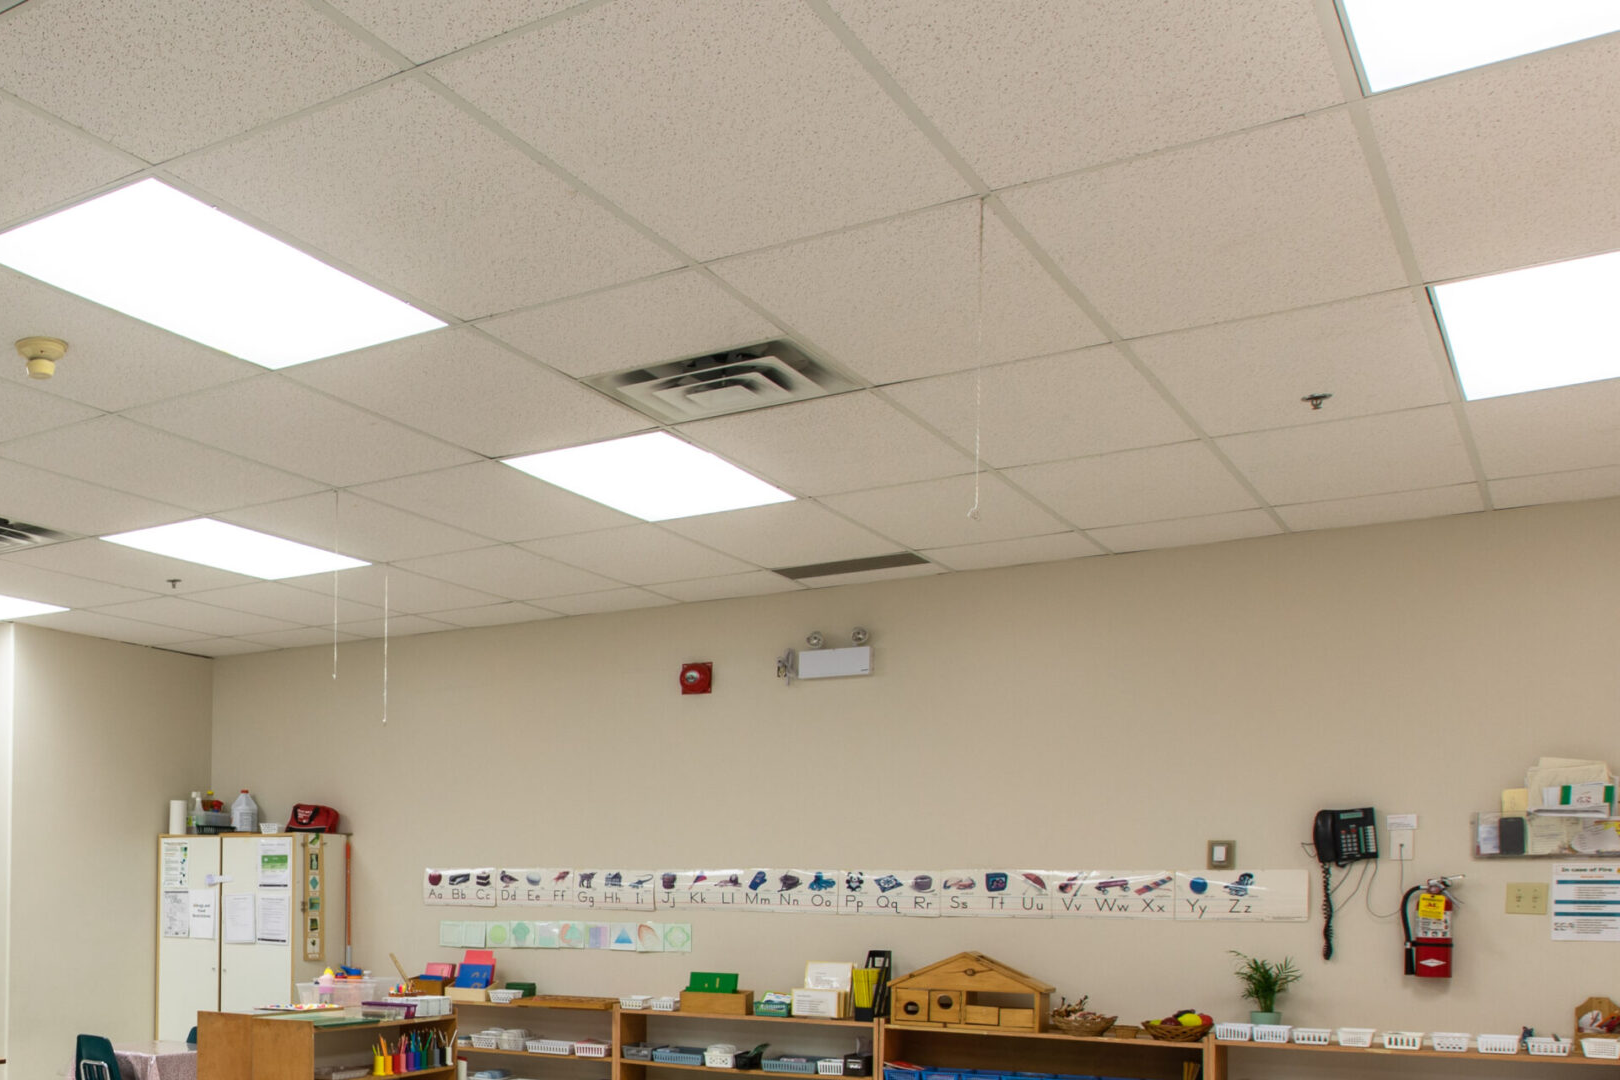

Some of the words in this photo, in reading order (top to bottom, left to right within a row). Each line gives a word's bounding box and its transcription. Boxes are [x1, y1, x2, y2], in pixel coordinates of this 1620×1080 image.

[428, 888, 443, 900] Aa
[451, 888, 467, 900] Bb
[475, 889, 491, 900] Cc
[501, 889, 517, 901] Dd
[527, 889, 541, 901] Ee
[553, 889, 567, 901] Ff
[577, 891, 595, 907] Gg
[604, 891, 621, 903] Hh
[661, 891, 675, 908] Jj
[690, 891, 706, 904] Kk
[745, 892, 771, 905] Mm
[780, 893, 799, 906] Nn
[811, 894, 832, 907] Oo
[845, 894, 864, 912] Pp
[876, 895, 900, 914] Qq
[914, 896, 932, 910] Rr
[950, 895, 968, 909] Ss
[987, 896, 1005, 910] Tt
[1022, 897, 1044, 911] Uu
[1062, 897, 1081, 911] Vv
[1094, 898, 1129, 912] Ww
[1141, 898, 1166, 913] Xx
[1186, 898, 1207, 920] Yy
[1228, 899, 1252, 914] Zz
